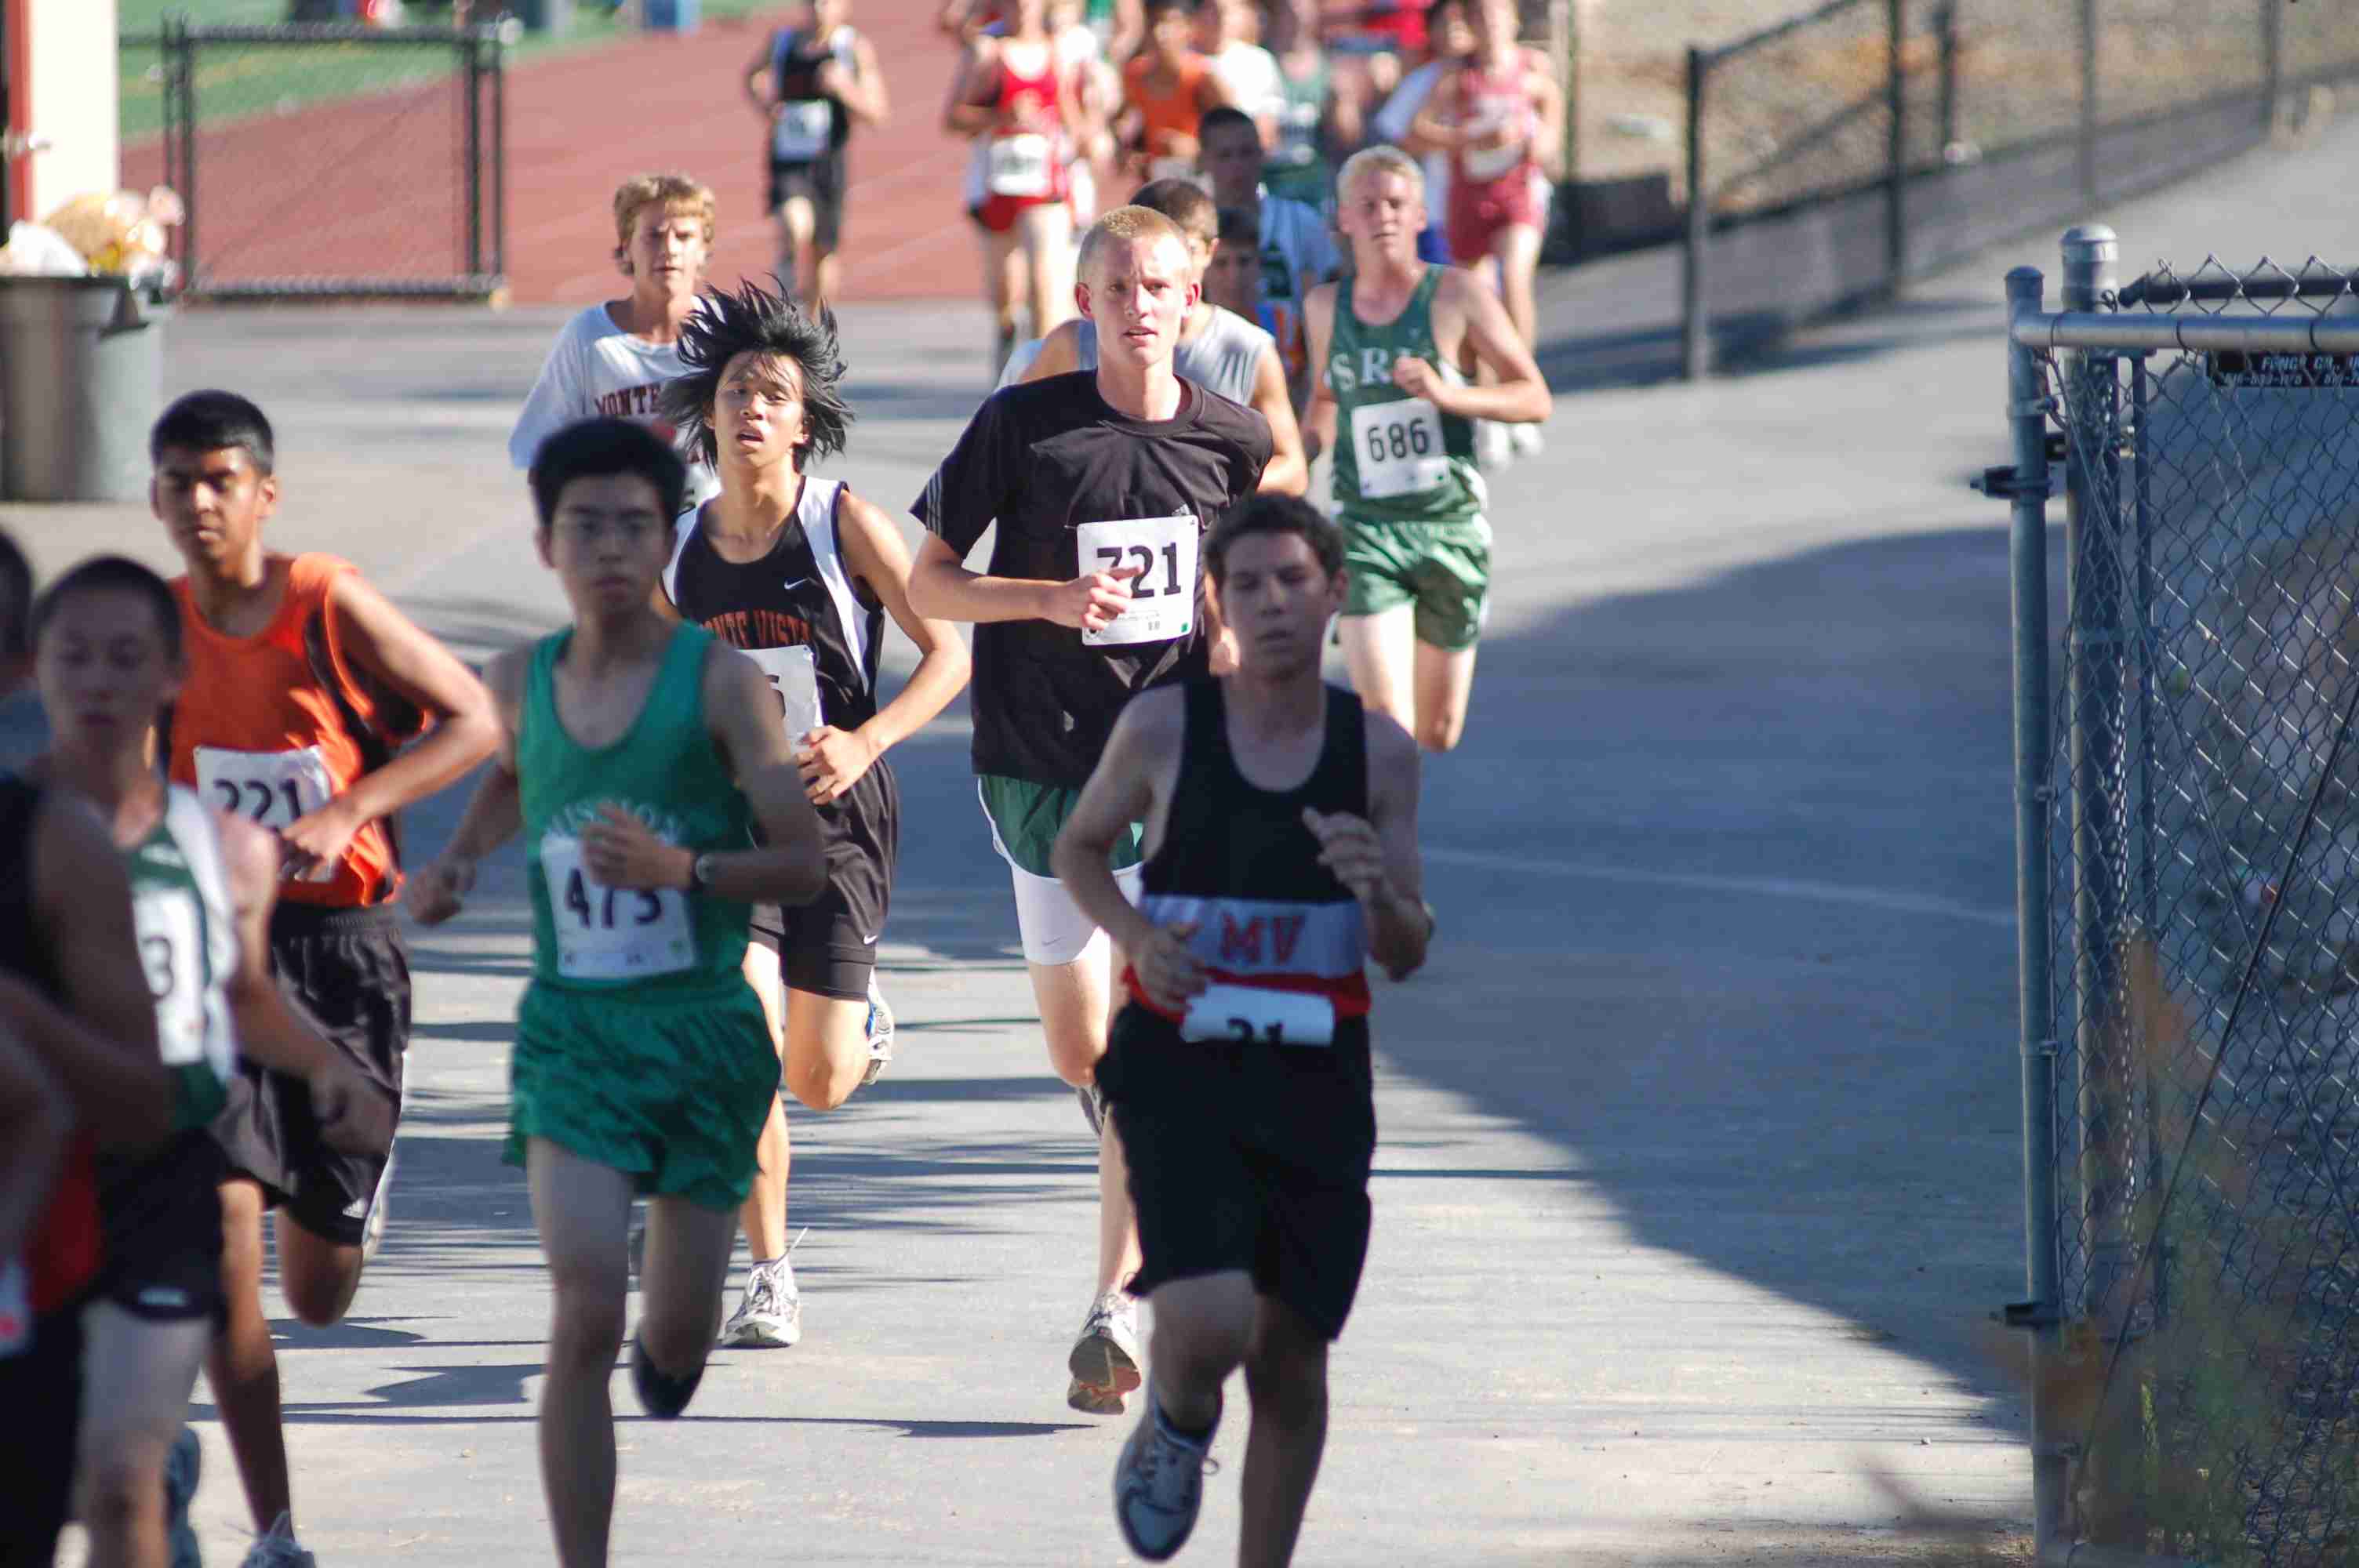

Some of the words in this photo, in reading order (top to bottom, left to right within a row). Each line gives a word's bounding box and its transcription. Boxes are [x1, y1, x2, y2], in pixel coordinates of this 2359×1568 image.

[1332, 346, 1434, 391] SR
[1367, 417, 1429, 463] 686
[1096, 542, 1182, 600] 721
[1220, 909, 1304, 964] MV
